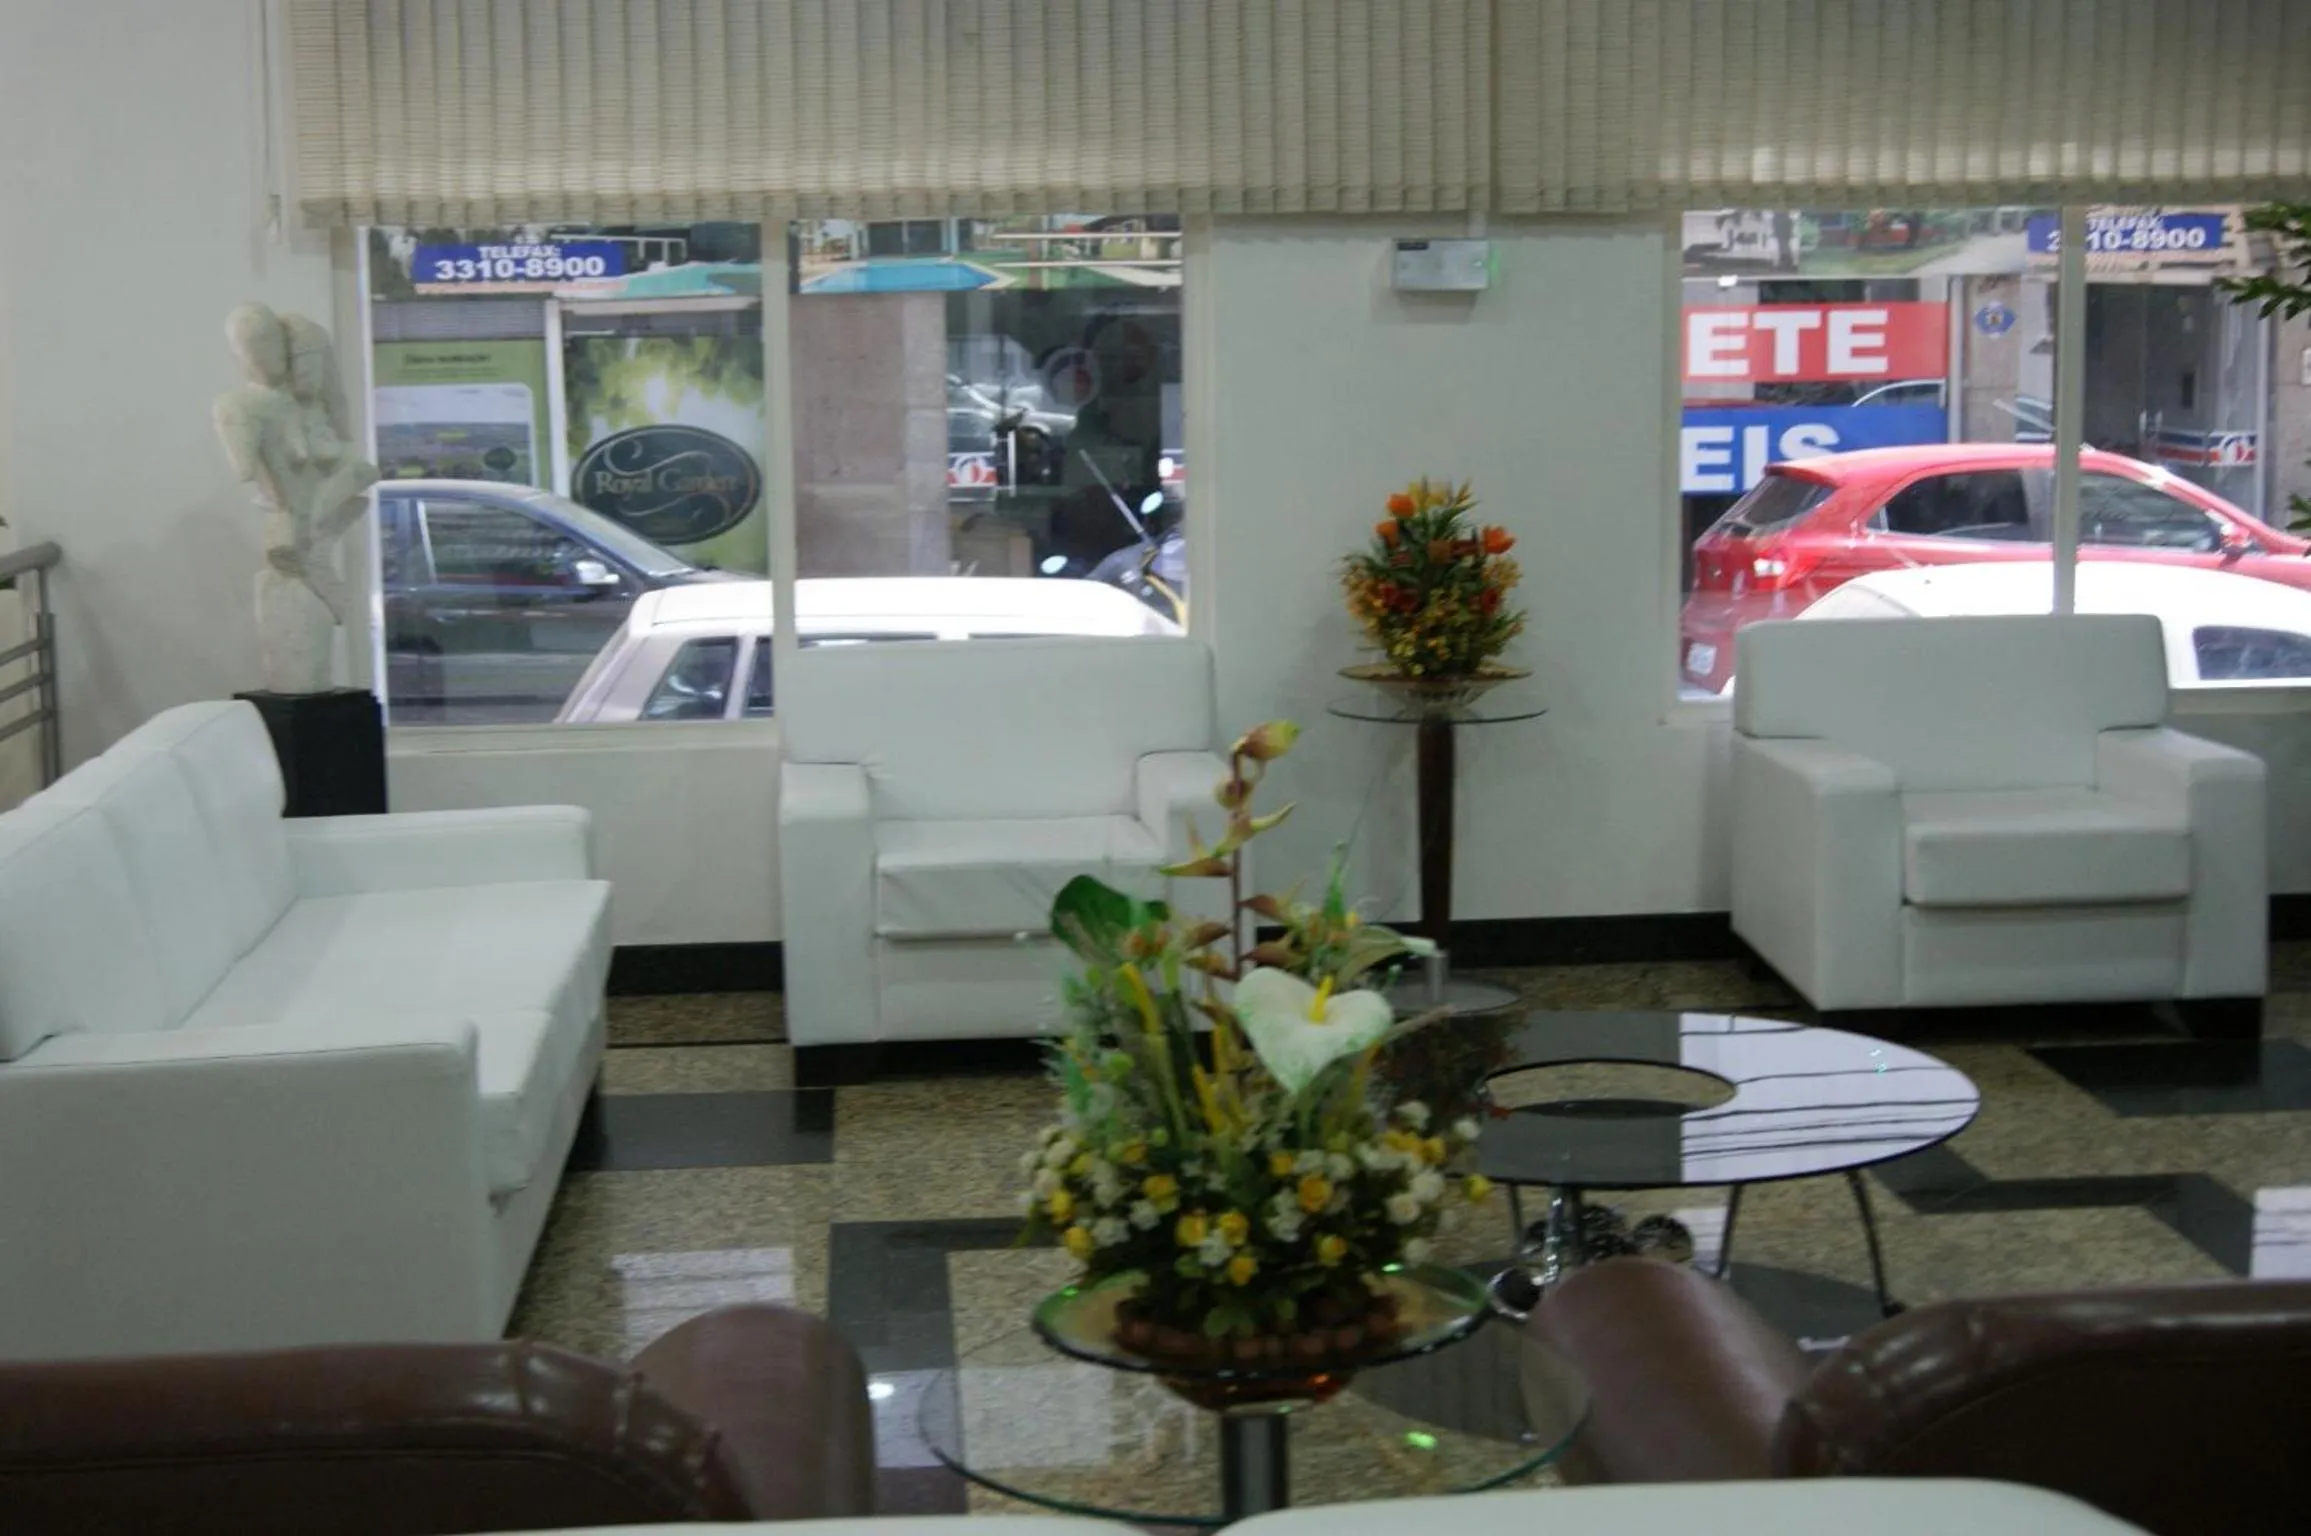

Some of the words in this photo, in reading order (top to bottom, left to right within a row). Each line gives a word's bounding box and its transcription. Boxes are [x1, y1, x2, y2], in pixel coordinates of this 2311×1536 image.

[434, 256, 606, 280] 3310-8900
[1688, 309, 1888, 376] ETE
[1680, 423, 1840, 493] EIS
[594, 469, 653, 501] Royal
